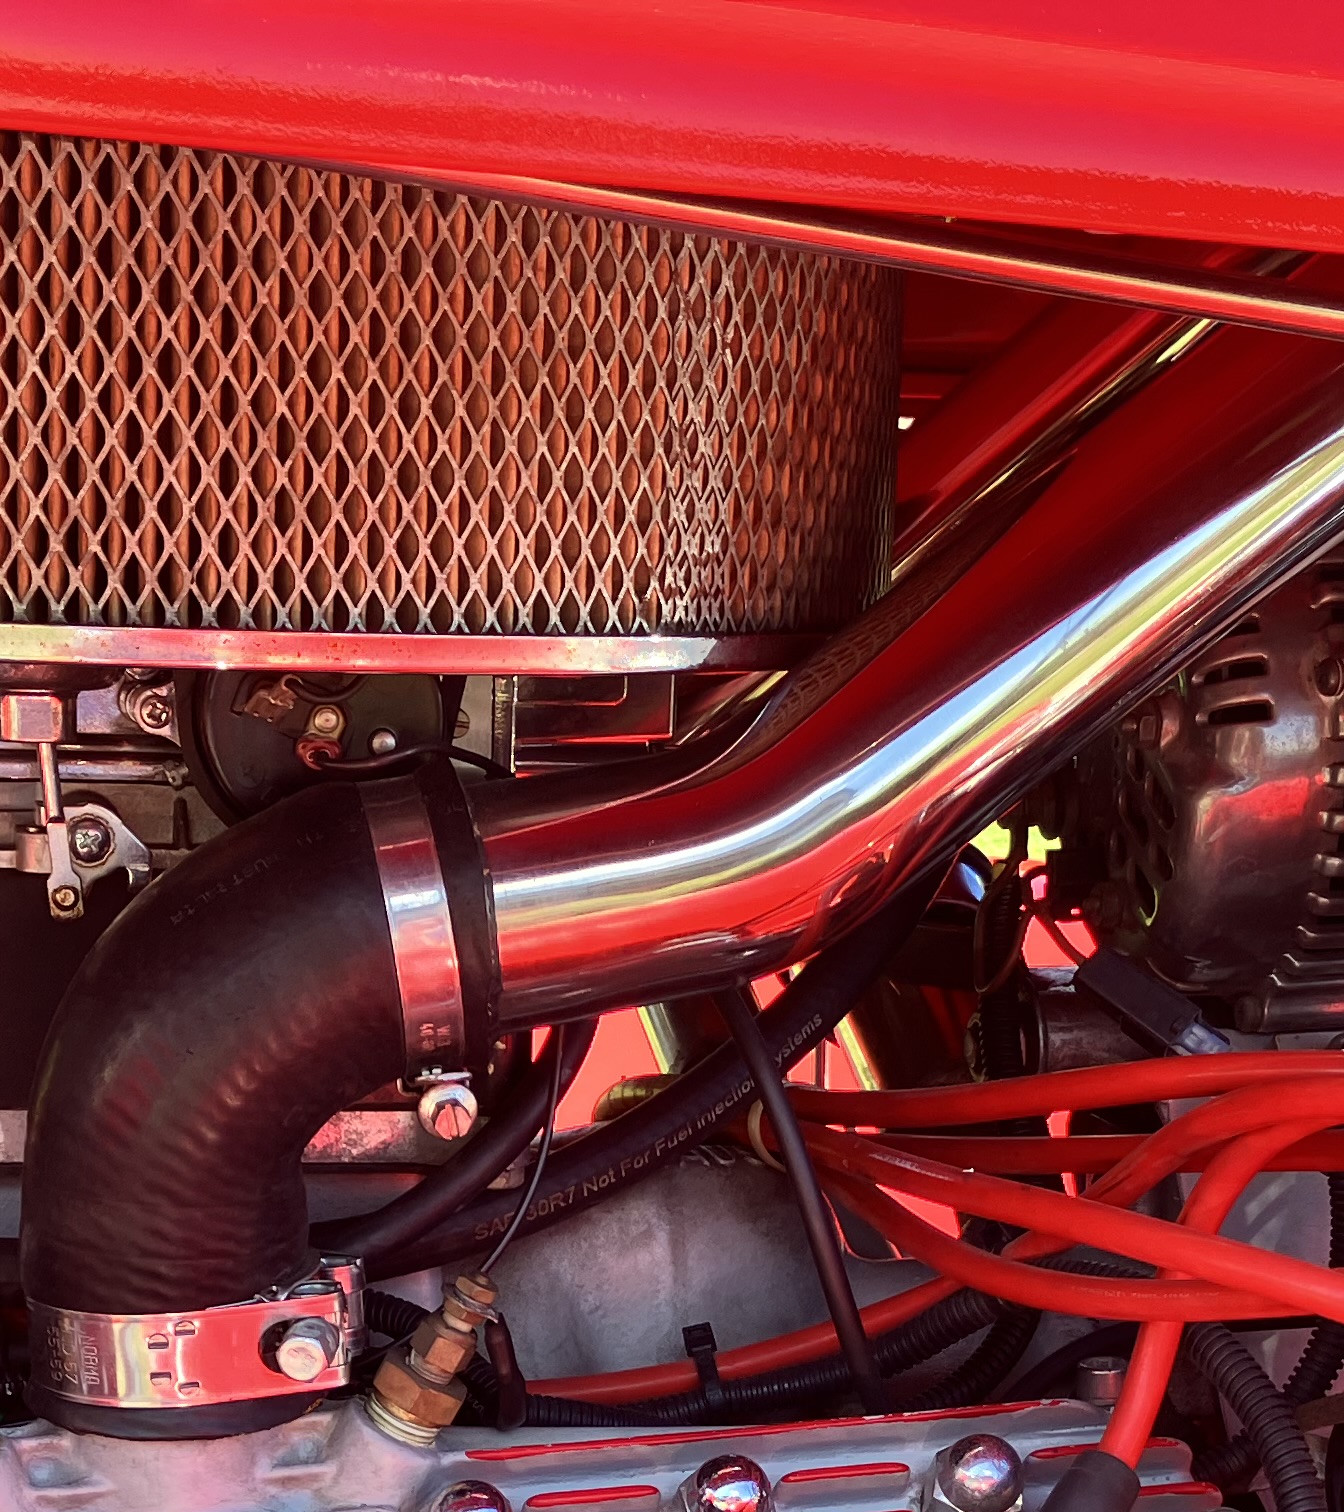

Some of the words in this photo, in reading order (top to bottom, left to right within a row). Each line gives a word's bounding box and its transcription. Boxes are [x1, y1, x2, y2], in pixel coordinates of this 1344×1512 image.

[582, 1166, 617, 1198] Not
[620, 1150, 652, 1178] For
[654, 1121, 693, 1157] Fuel
[773, 1013, 824, 1068] ystems
